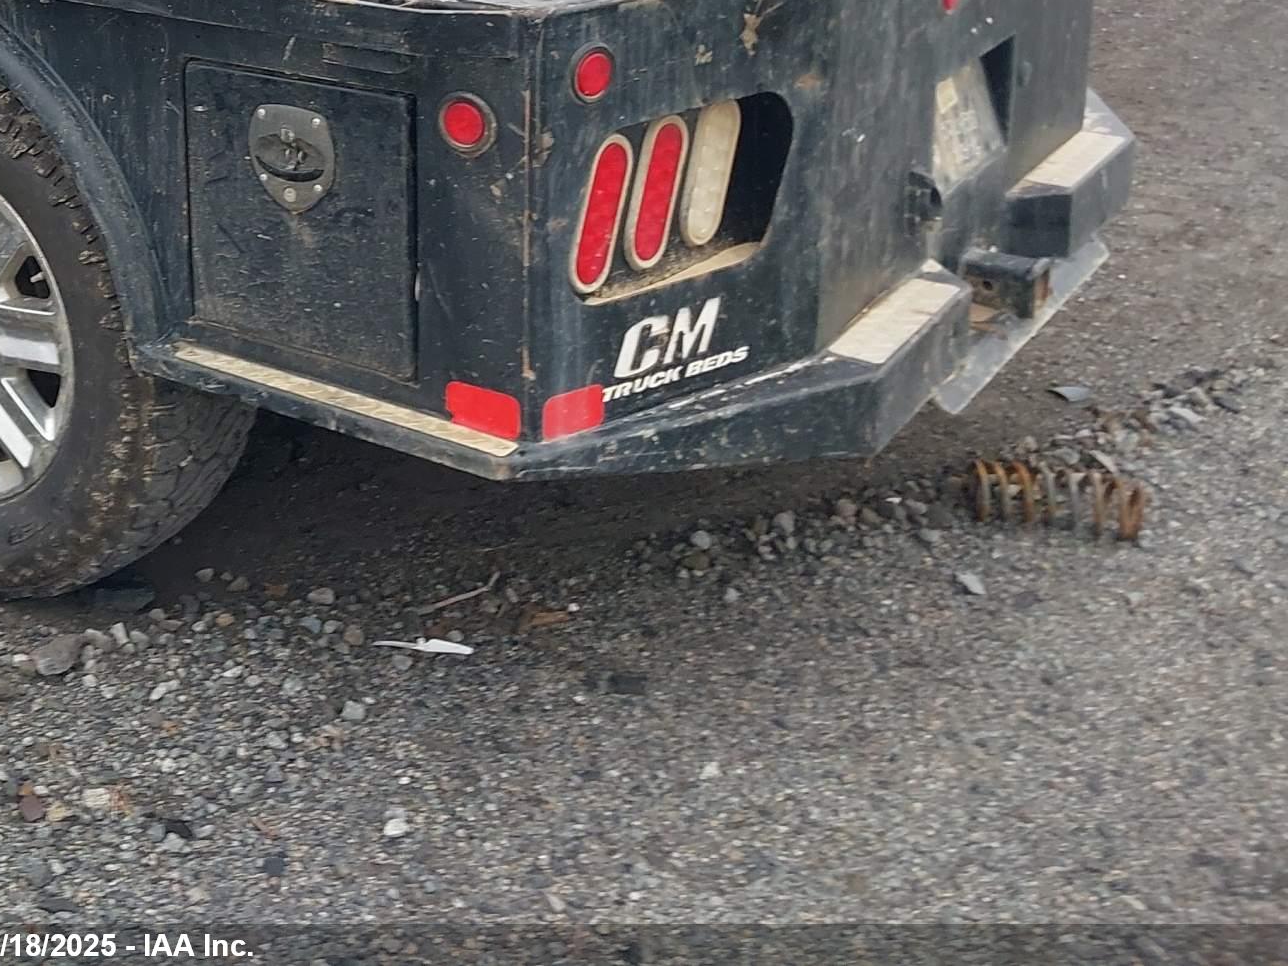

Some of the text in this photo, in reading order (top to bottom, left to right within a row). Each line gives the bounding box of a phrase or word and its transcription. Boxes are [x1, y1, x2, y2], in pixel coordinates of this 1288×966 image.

[613, 297, 722, 379] CM
[602, 345, 750, 402] TRUCK BEDS
